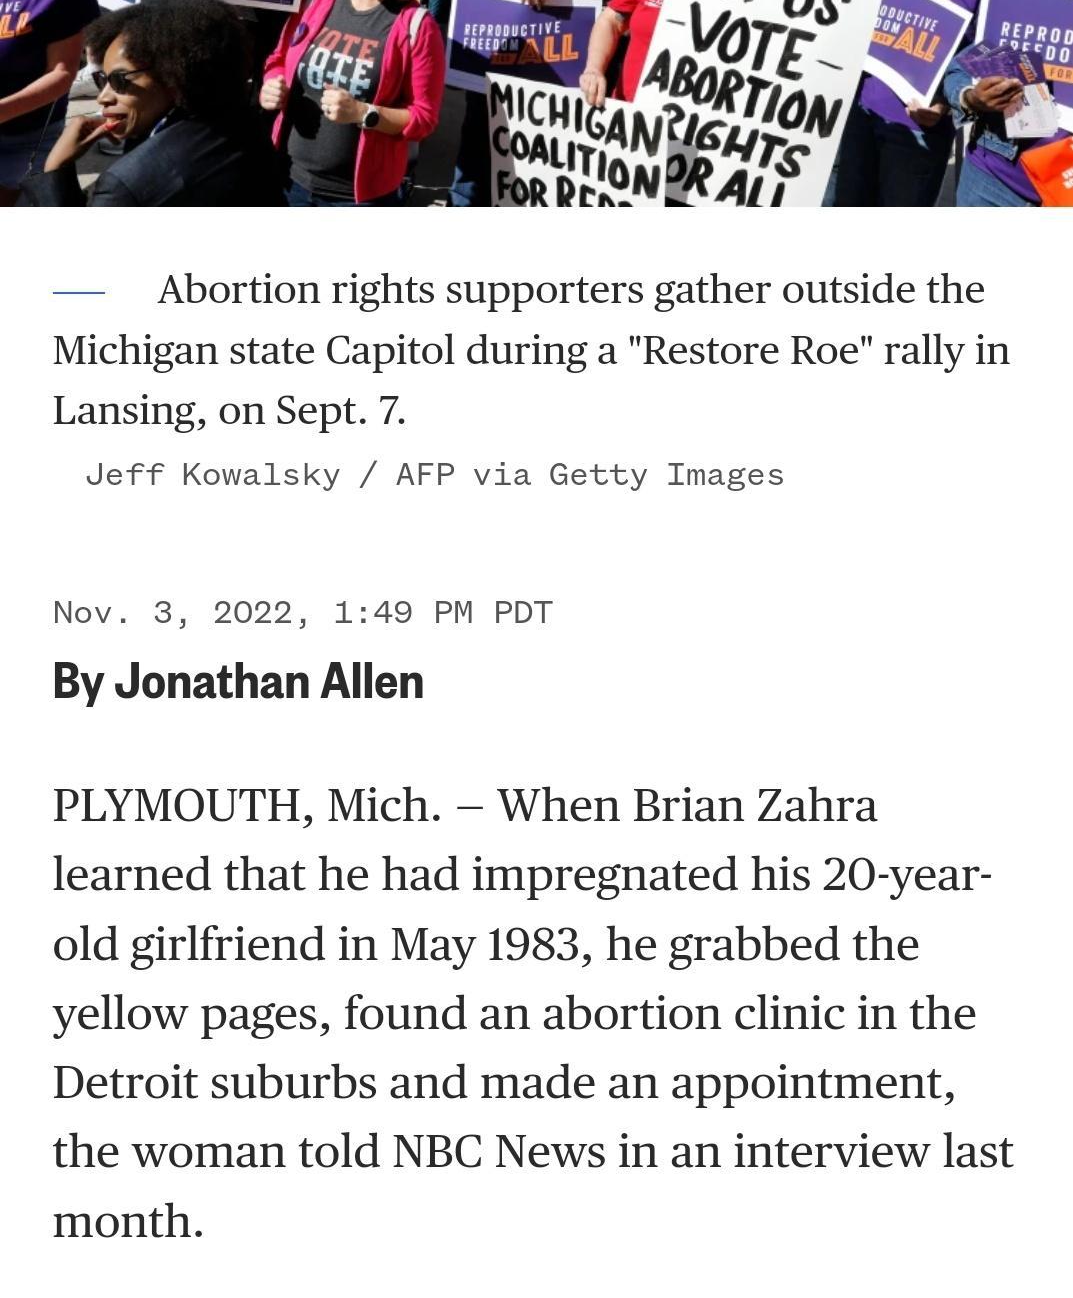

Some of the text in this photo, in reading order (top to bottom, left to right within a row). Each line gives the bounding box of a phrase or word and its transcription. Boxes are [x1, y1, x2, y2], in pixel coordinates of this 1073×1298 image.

[464, 20, 562, 36] REPRODUCTIVE
[690, 1, 817, 81] VOTE
[879, 5, 939, 33] ODUCTIVE
[463, 38, 519, 51] FREEDOM
[518, 33, 579, 65] ALL
[893, 27, 940, 63] ALL
[642, 48, 843, 139] ABORTION
[490, 81, 663, 157] MICHIGAN
[662, 103, 811, 179] RIGHTS
[492, 125, 661, 199] COALITION
[666, 153, 714, 198] OR
[497, 170, 548, 207] FOR
